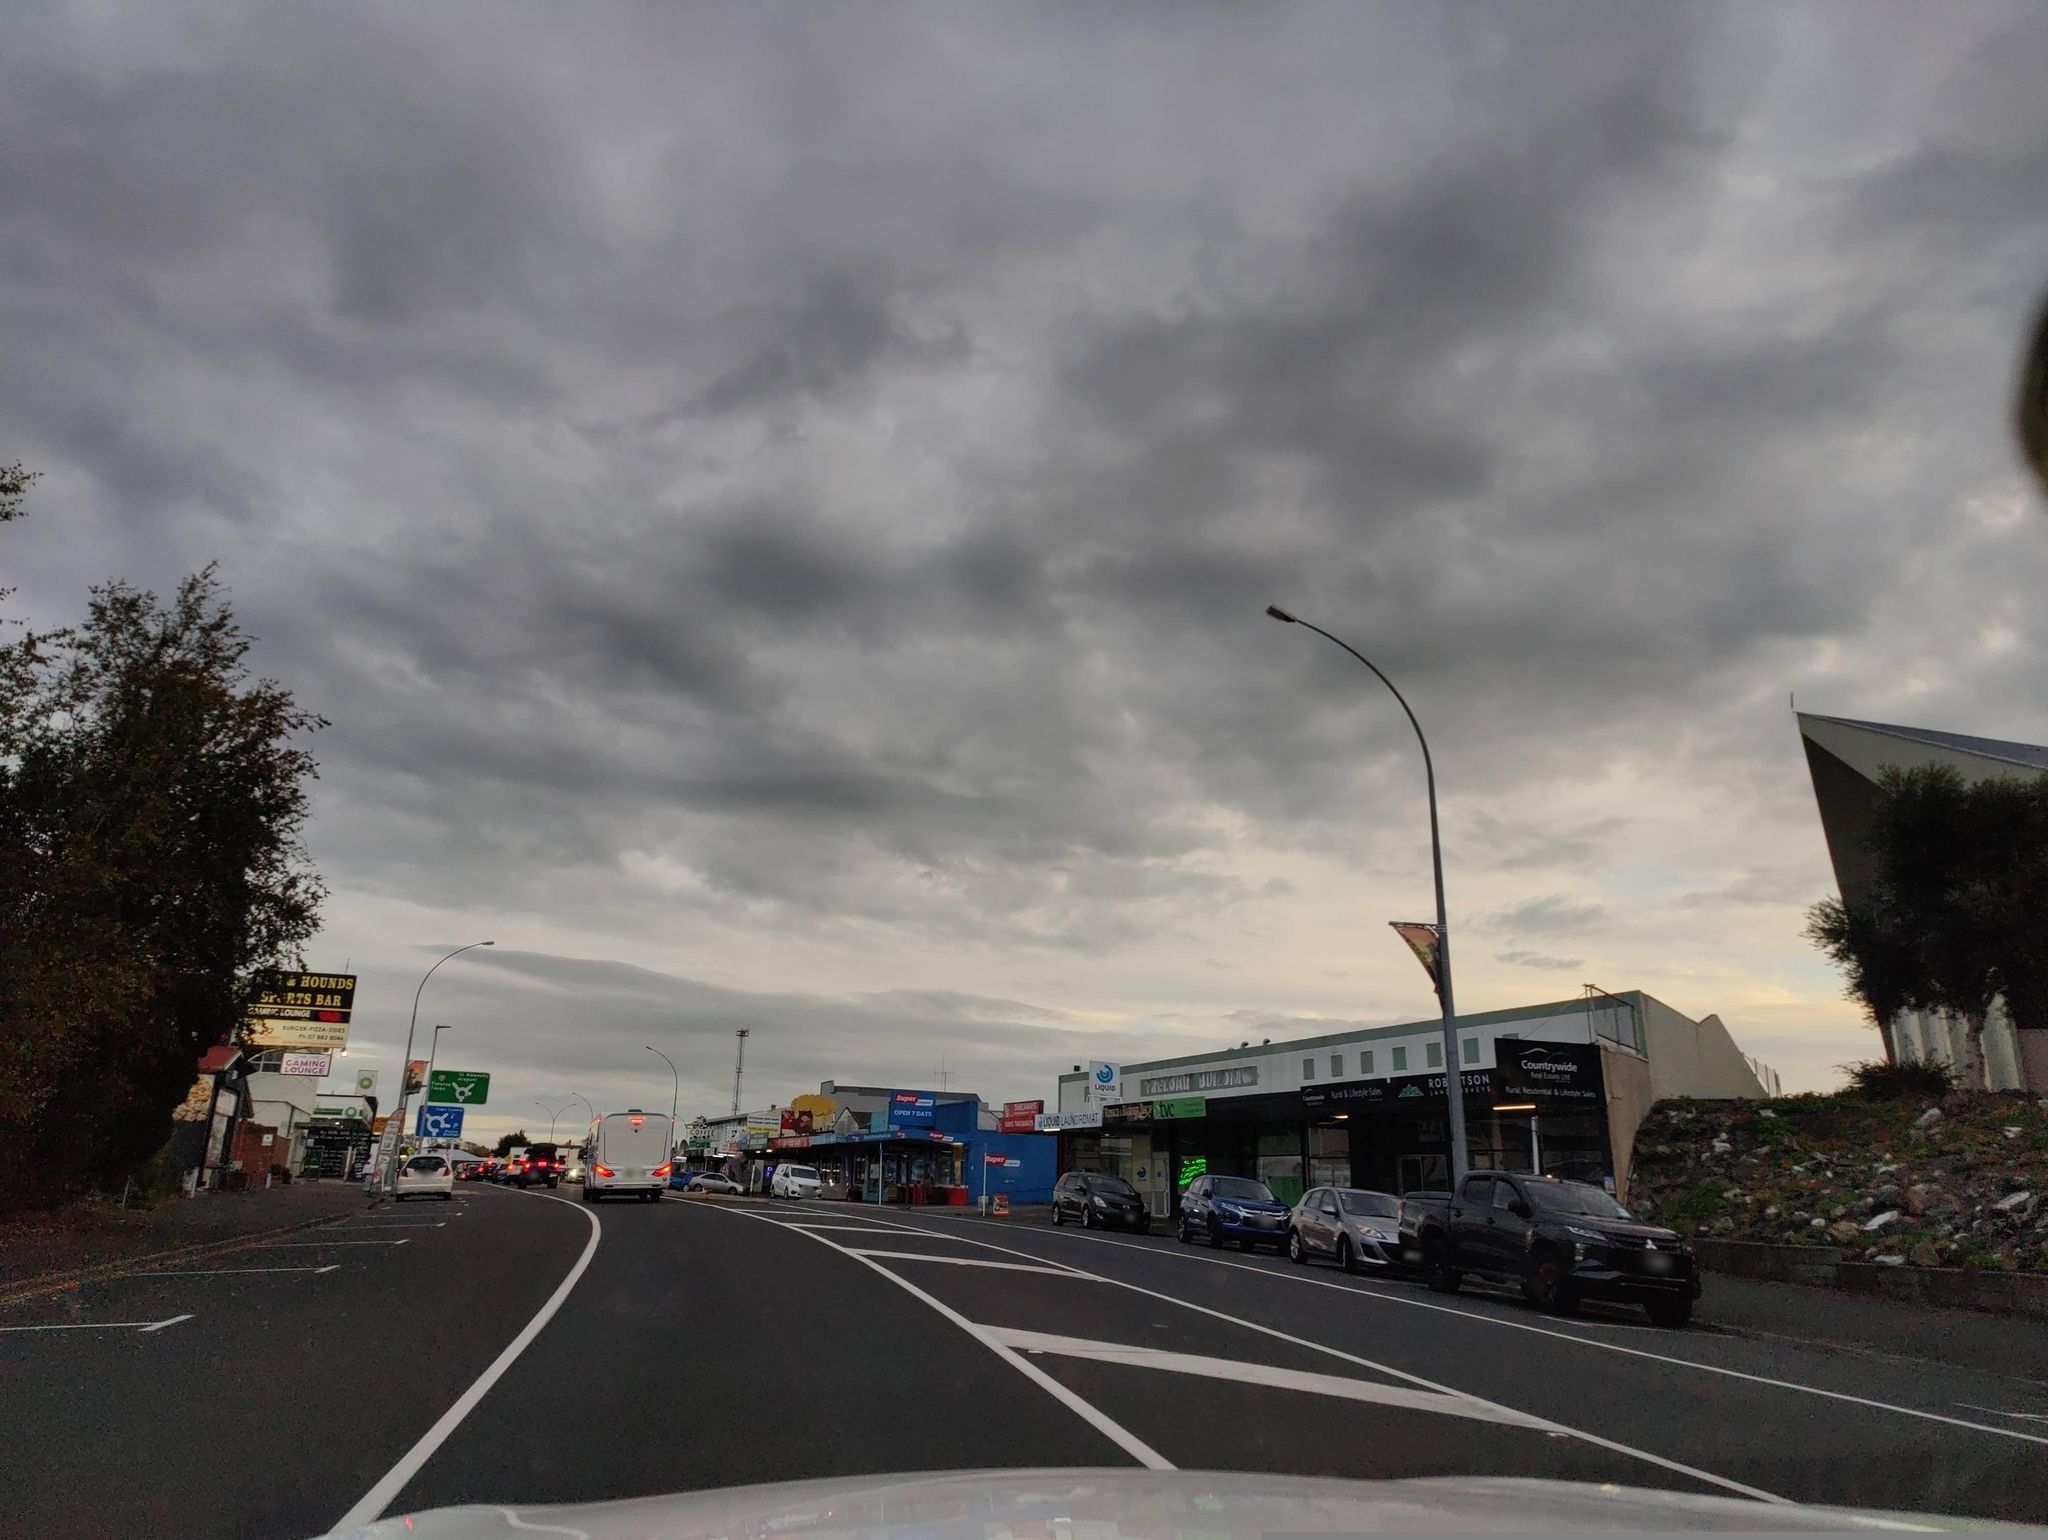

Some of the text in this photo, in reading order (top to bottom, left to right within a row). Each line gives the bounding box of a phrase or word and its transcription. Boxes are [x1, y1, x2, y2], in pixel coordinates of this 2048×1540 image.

[301, 976, 354, 990] HOUNDS
[261, 991, 341, 1006] SPRTS BAR
[280, 1009, 311, 1018] LOUNGE
[285, 1059, 326, 1068] GAMING
[1521, 1060, 1578, 1073] Countrywide
[284, 1067, 325, 1075] LOUNGE
[1198, 1068, 1253, 1089] BUIDING
[1428, 1074, 1490, 1088] ROBTSON
[1095, 1083, 1116, 1092] LIQUID
[1159, 1102, 1175, 1118] tvc
[1043, 1113, 1099, 1128] LIQUID LAUNDROMAT
[986, 1155, 1005, 1163] Super
